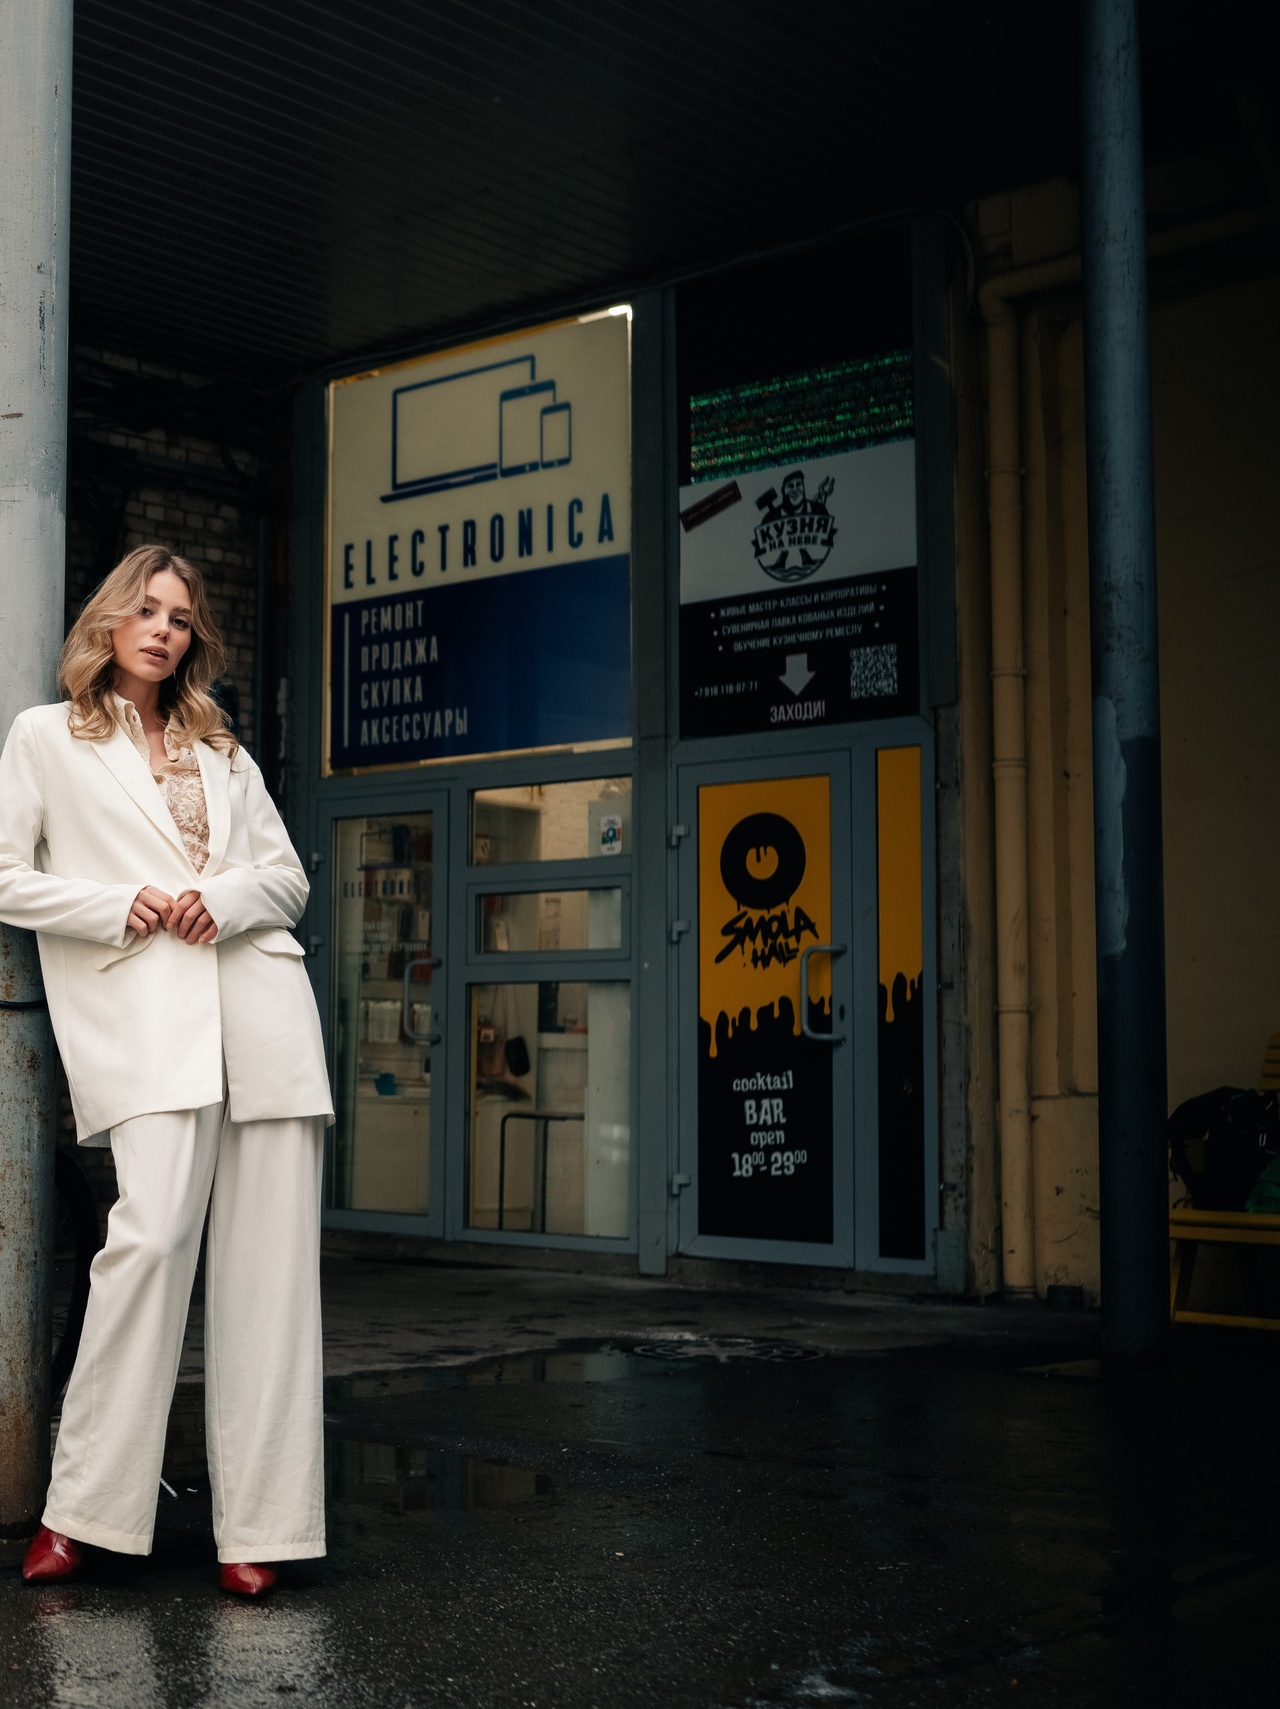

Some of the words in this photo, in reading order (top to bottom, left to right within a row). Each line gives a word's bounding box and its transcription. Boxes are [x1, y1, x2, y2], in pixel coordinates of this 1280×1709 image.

[344, 493, 614, 589] ELECTRONICA
[760, 517, 829, 545] КУЗНЯ
[769, 540, 785, 551] НА
[789, 535, 818, 547] НЕВЕ
[361, 599, 424, 637] РЕМОНТ
[361, 635, 439, 673] ПРОДАЖА
[361, 675, 423, 710] СКУПКА
[770, 699, 826, 723] ЗАХОДИ!
[360, 706, 468, 747] АКСЕССУАРЫ
[715, 906, 819, 963] SMOLA
[751, 942, 799, 969] HALL
[732, 1069, 794, 1092] cocktail
[744, 1097, 787, 1126] BAR
[750, 1129, 785, 1149] open
